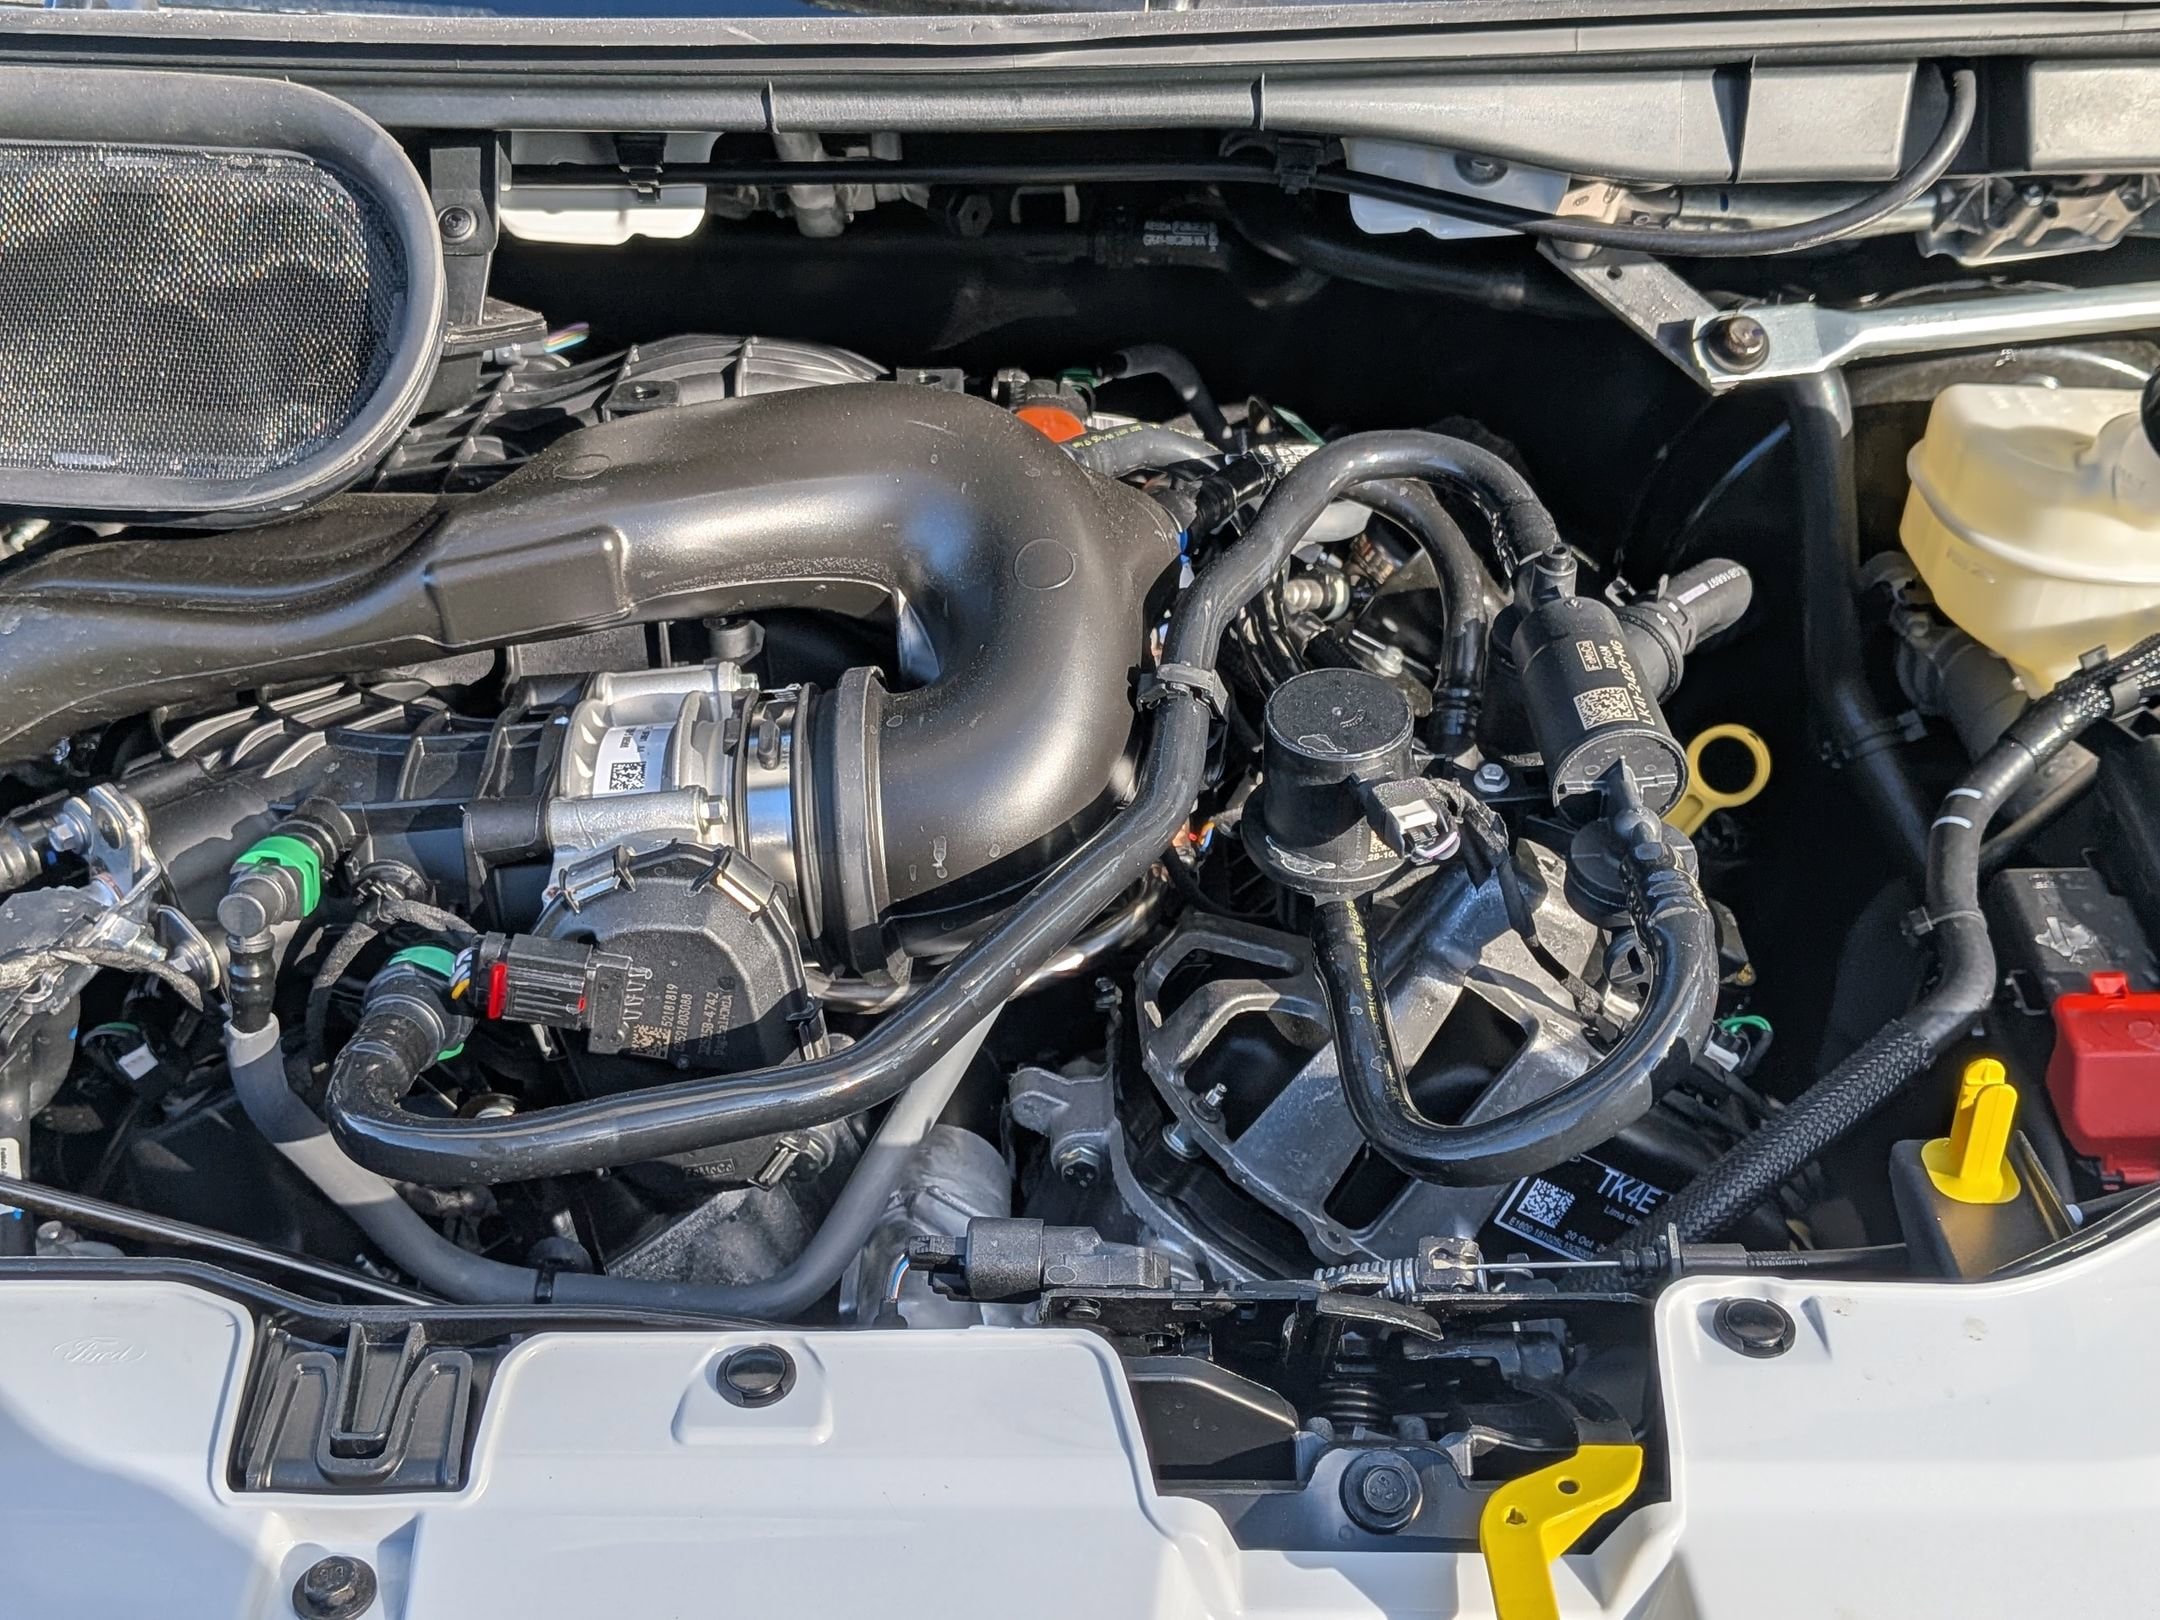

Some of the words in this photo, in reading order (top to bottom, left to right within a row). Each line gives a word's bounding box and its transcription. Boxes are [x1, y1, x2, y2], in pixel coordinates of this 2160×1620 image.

[1581, 641, 1601, 672] FoMoCo
[661, 983, 679, 1028] 52181819
[1597, 1167, 1664, 1214] TK4E
[60, 1340, 138, 1364] Ford
